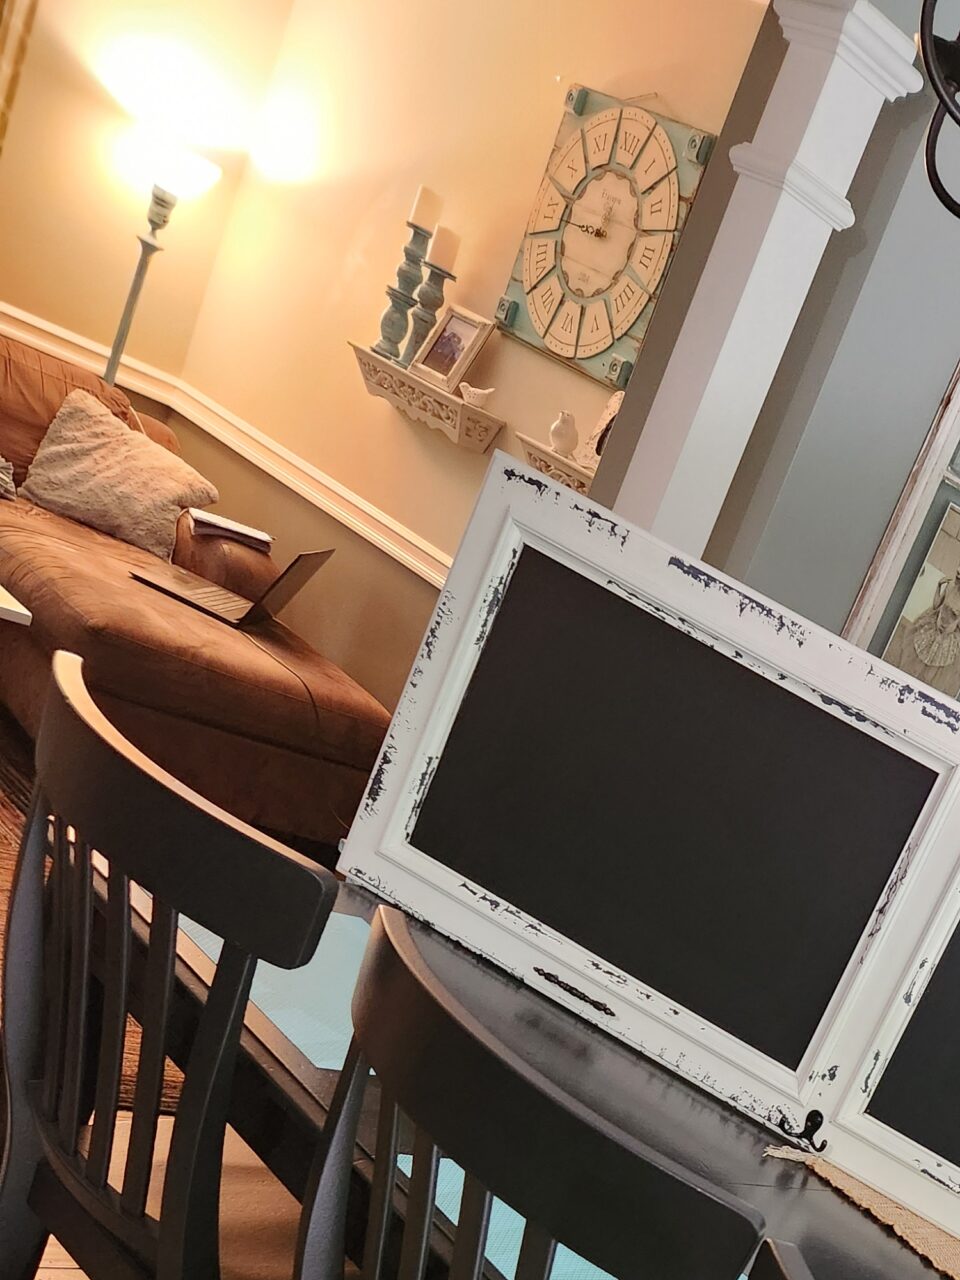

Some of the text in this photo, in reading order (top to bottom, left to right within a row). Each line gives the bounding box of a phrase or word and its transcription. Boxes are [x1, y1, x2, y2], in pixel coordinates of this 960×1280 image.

[592, 131, 609, 156] XI
[618, 130, 640, 156] XII
[640, 245, 655, 270] III
